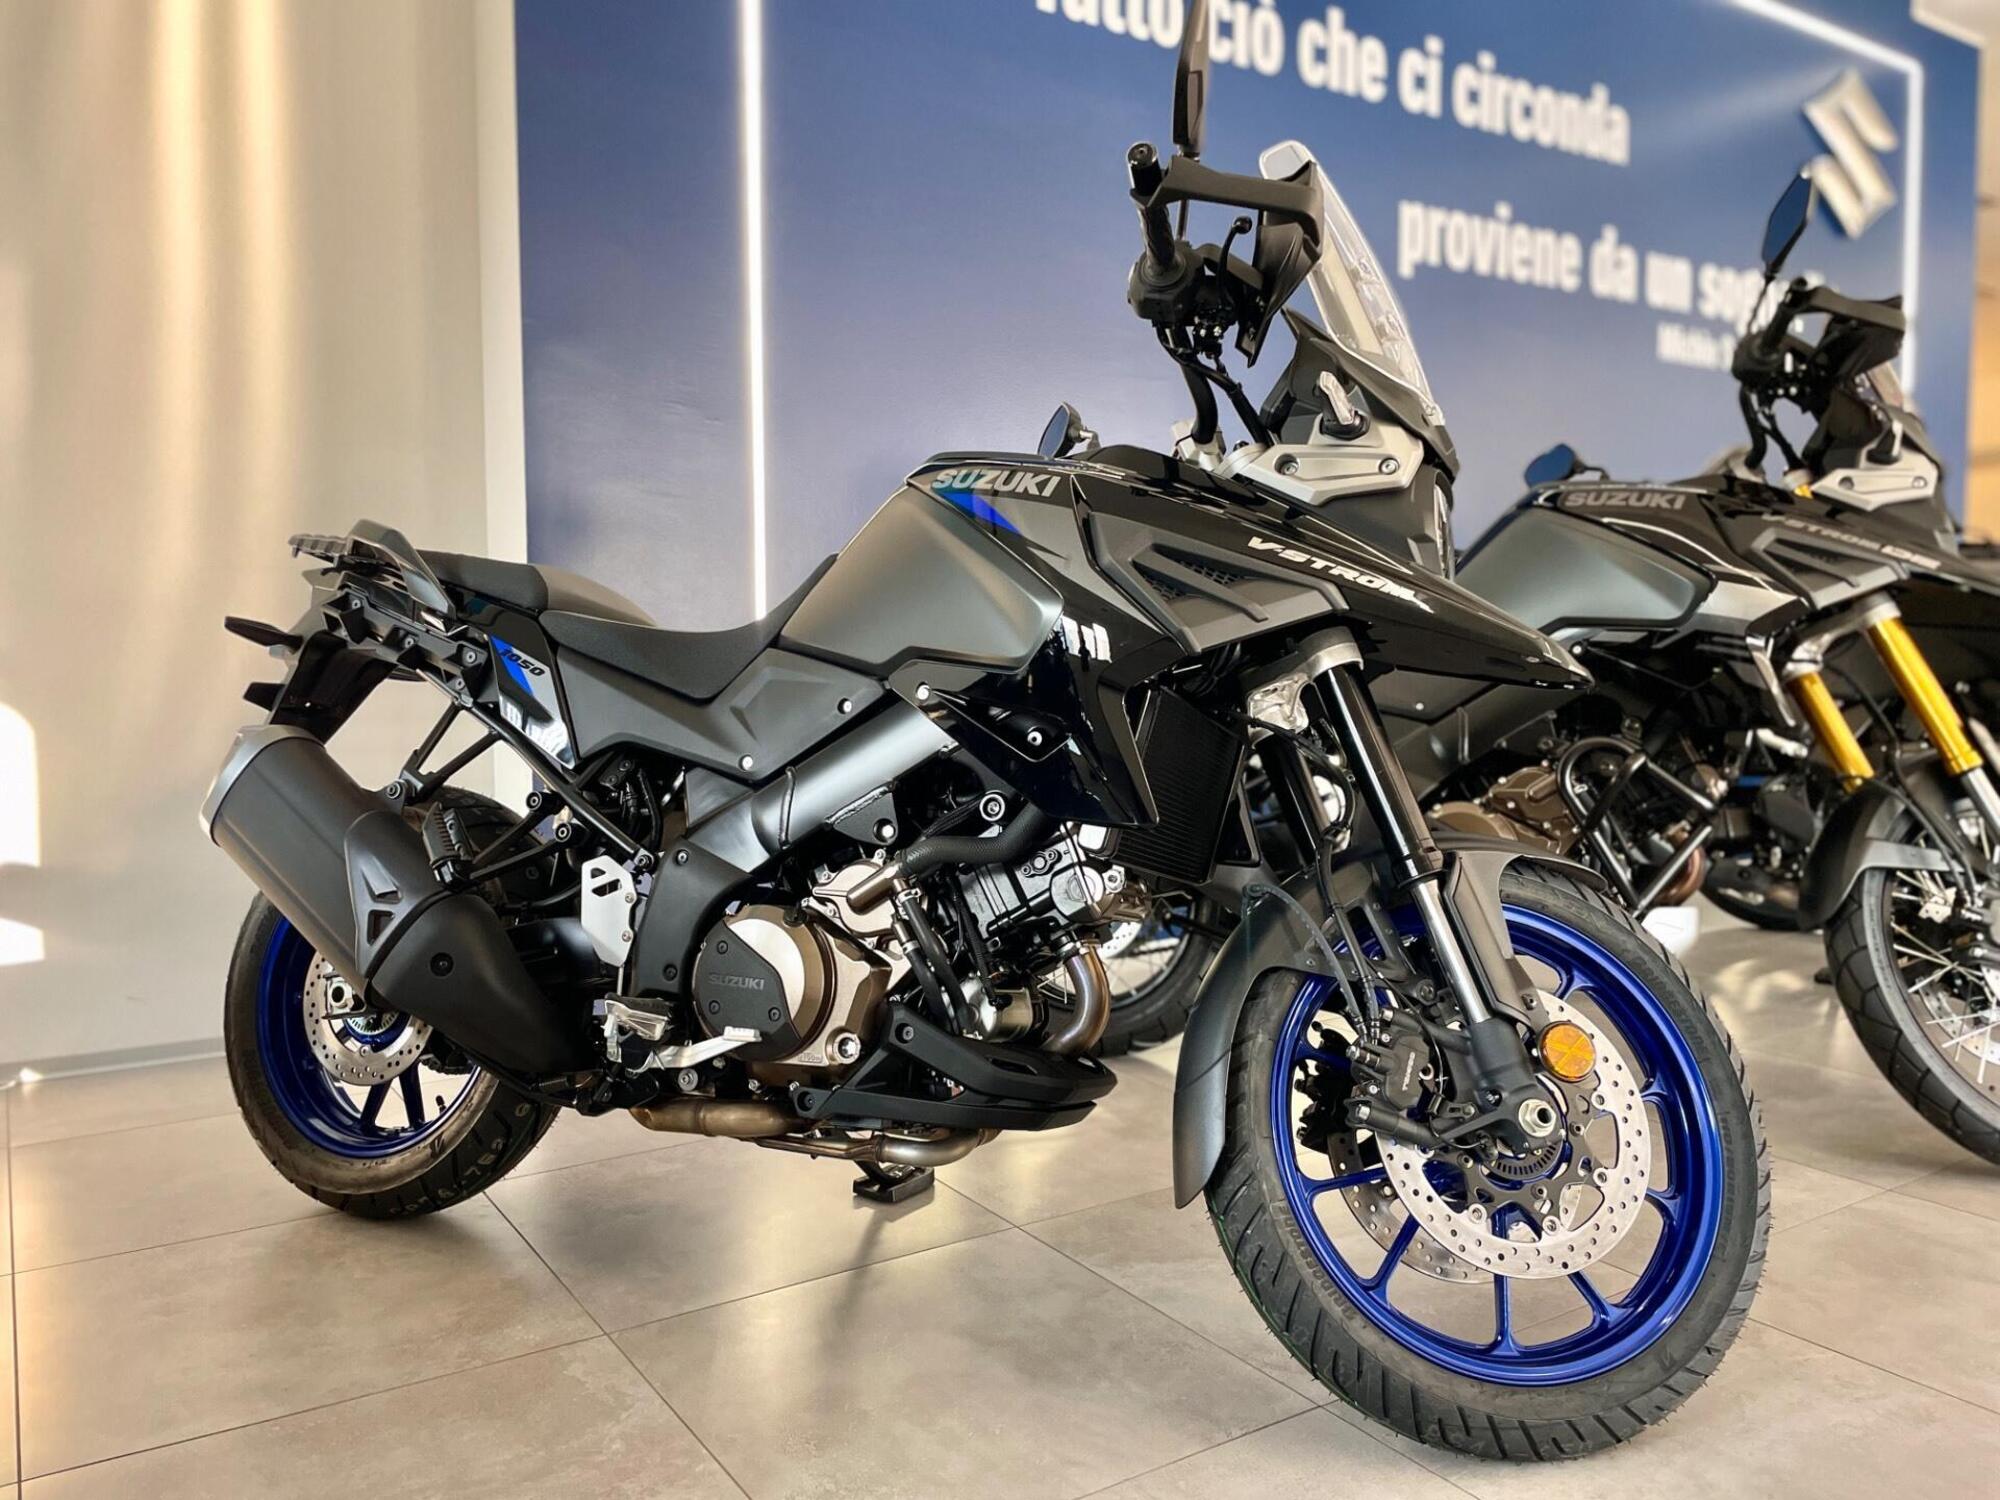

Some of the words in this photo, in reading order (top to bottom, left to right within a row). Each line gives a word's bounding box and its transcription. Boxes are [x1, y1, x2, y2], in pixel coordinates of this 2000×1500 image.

[1296, 5, 1388, 104] che
[1397, 35, 1444, 119] ci
[1451, 50, 1632, 167] circonda
[1397, 200, 1583, 293] proviene
[1589, 223, 1639, 303] da
[931, 468, 1061, 497] SUZUKI
[1565, 491, 1686, 510] SUZUKI
[1247, 536, 1427, 609] V-STROM
[499, 649, 546, 676] 1050
[708, 972, 765, 991] SUZUKI
